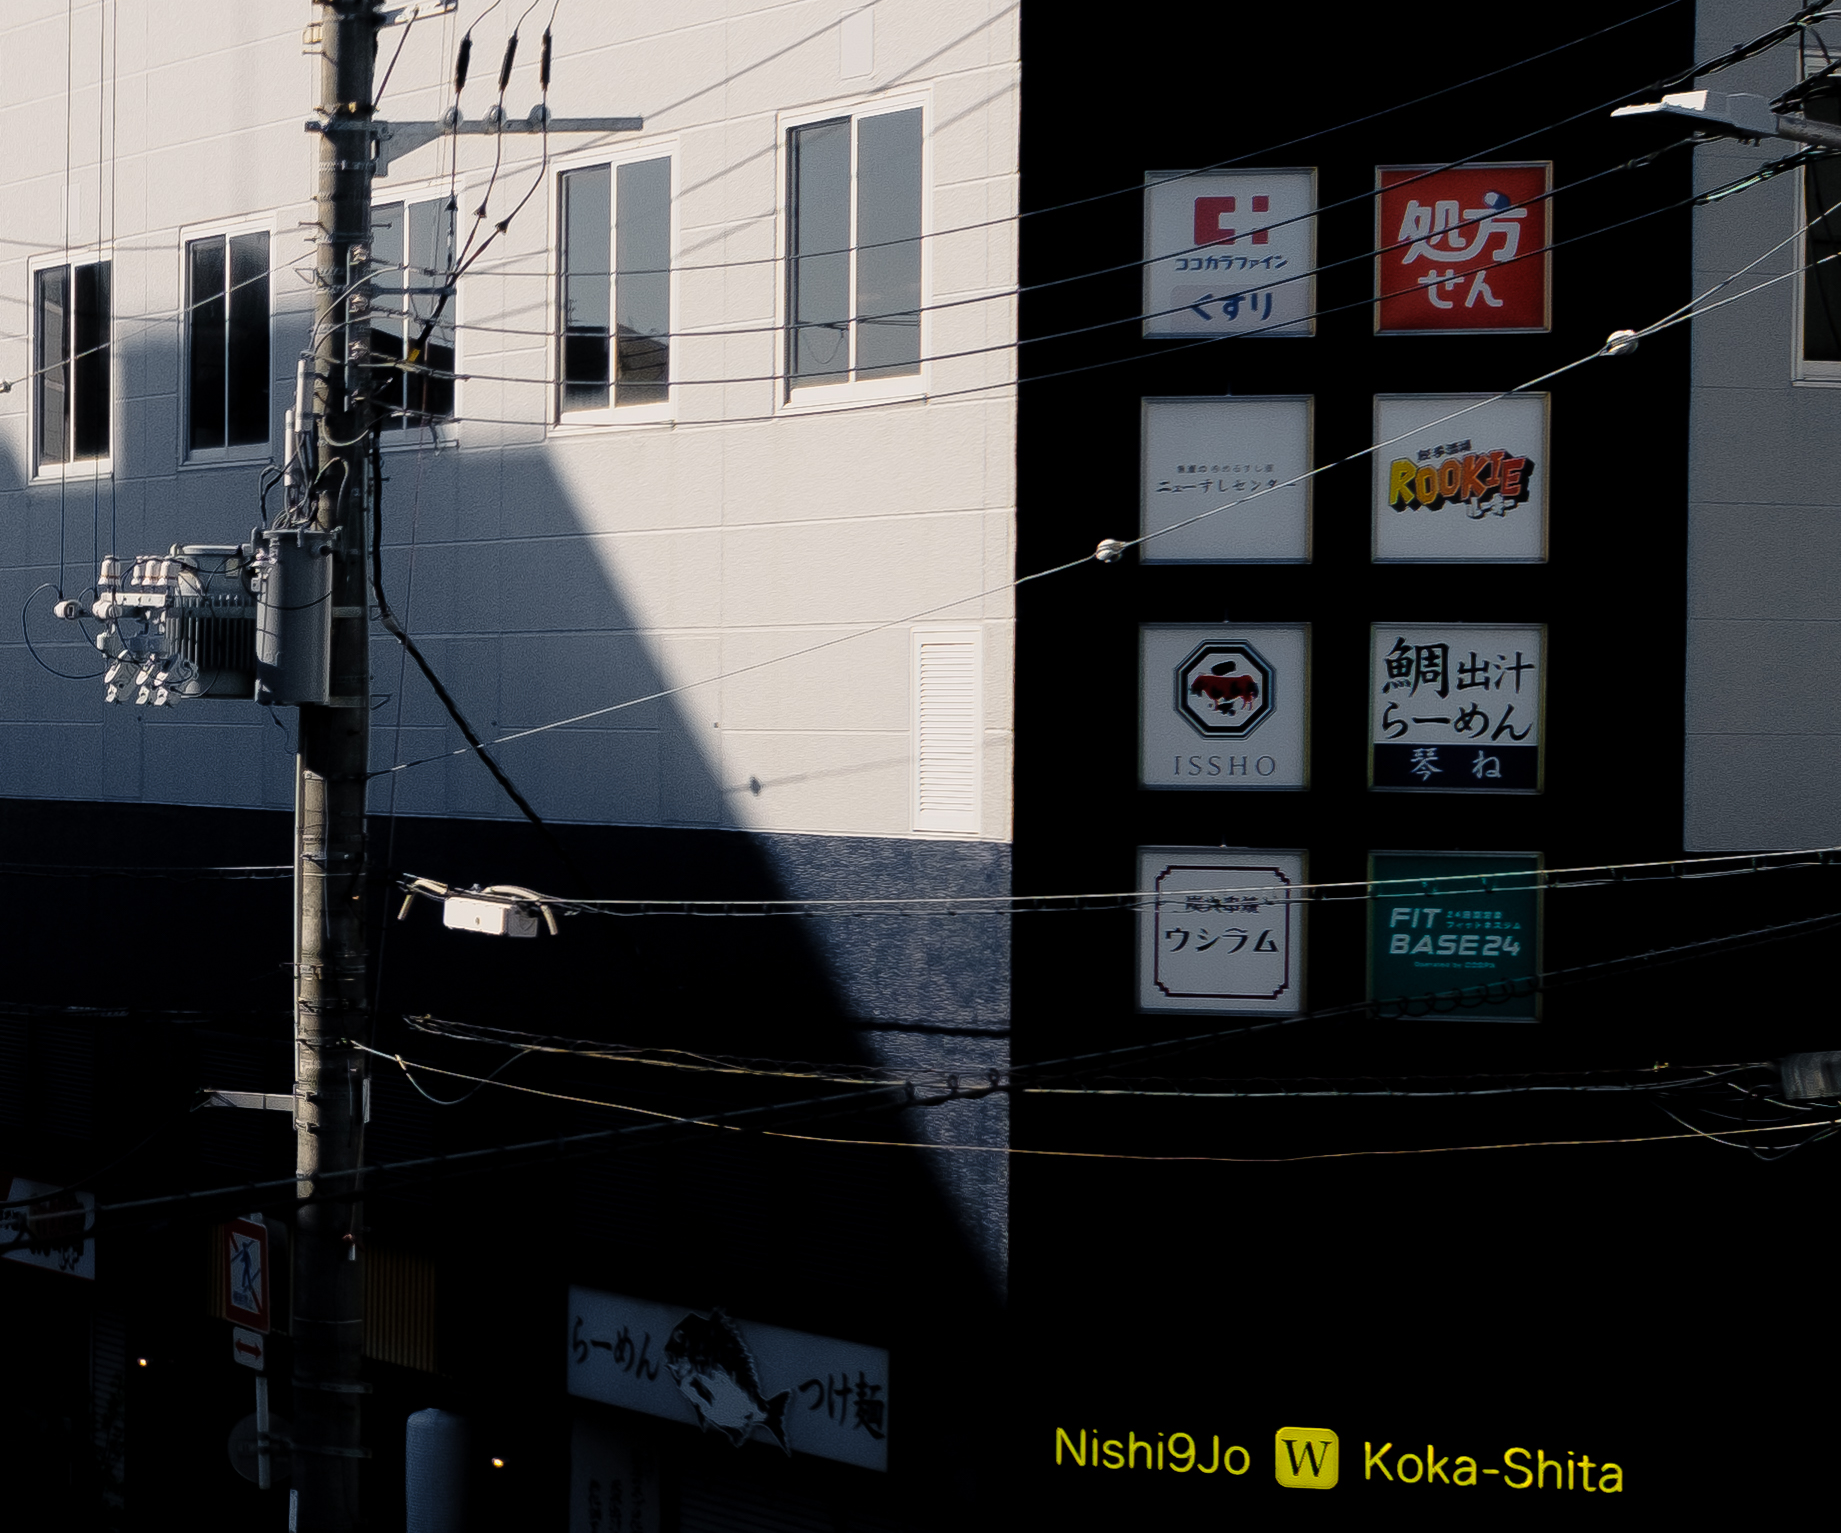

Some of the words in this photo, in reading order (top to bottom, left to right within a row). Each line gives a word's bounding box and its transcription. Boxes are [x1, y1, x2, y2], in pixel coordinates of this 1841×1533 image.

[1398, 192, 1528, 264] 処方
[1175, 254, 1288, 271] ココカラファイン
[1191, 292, 1273, 321] くすり
[1417, 269, 1504, 309] せん
[1155, 478, 1296, 494] ニューすしセンター
[1389, 449, 1532, 509] ROOKIE
[1381, 636, 1536, 699] 鯛出汁
[1381, 701, 1534, 742] らーめん
[1174, 755, 1276, 777] ISSHO
[1389, 907, 1443, 929] FIT
[1164, 927, 1279, 955] ウシラム
[572, 1315, 658, 1381] らーめん
[799, 1370, 885, 1440] つけ麺
[1054, 1426, 1252, 1476] Nishi9Jo
[1363, 1440, 1624, 1494] Koka-Shita
